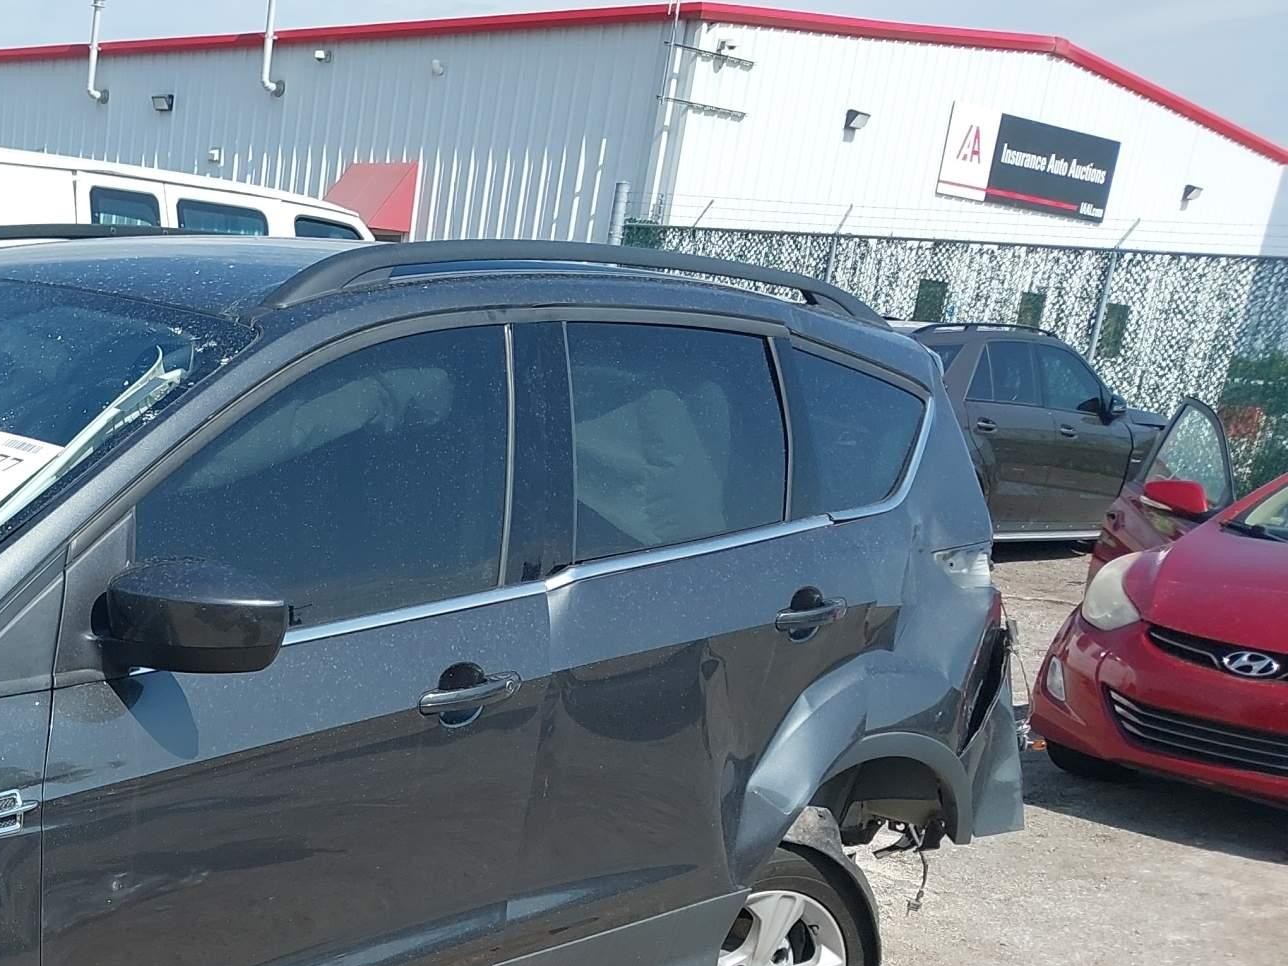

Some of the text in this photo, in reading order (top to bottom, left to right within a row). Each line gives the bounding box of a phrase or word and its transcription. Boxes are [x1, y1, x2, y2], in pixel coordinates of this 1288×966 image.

[1000, 142, 1107, 185] Insurance Auto Auctions
